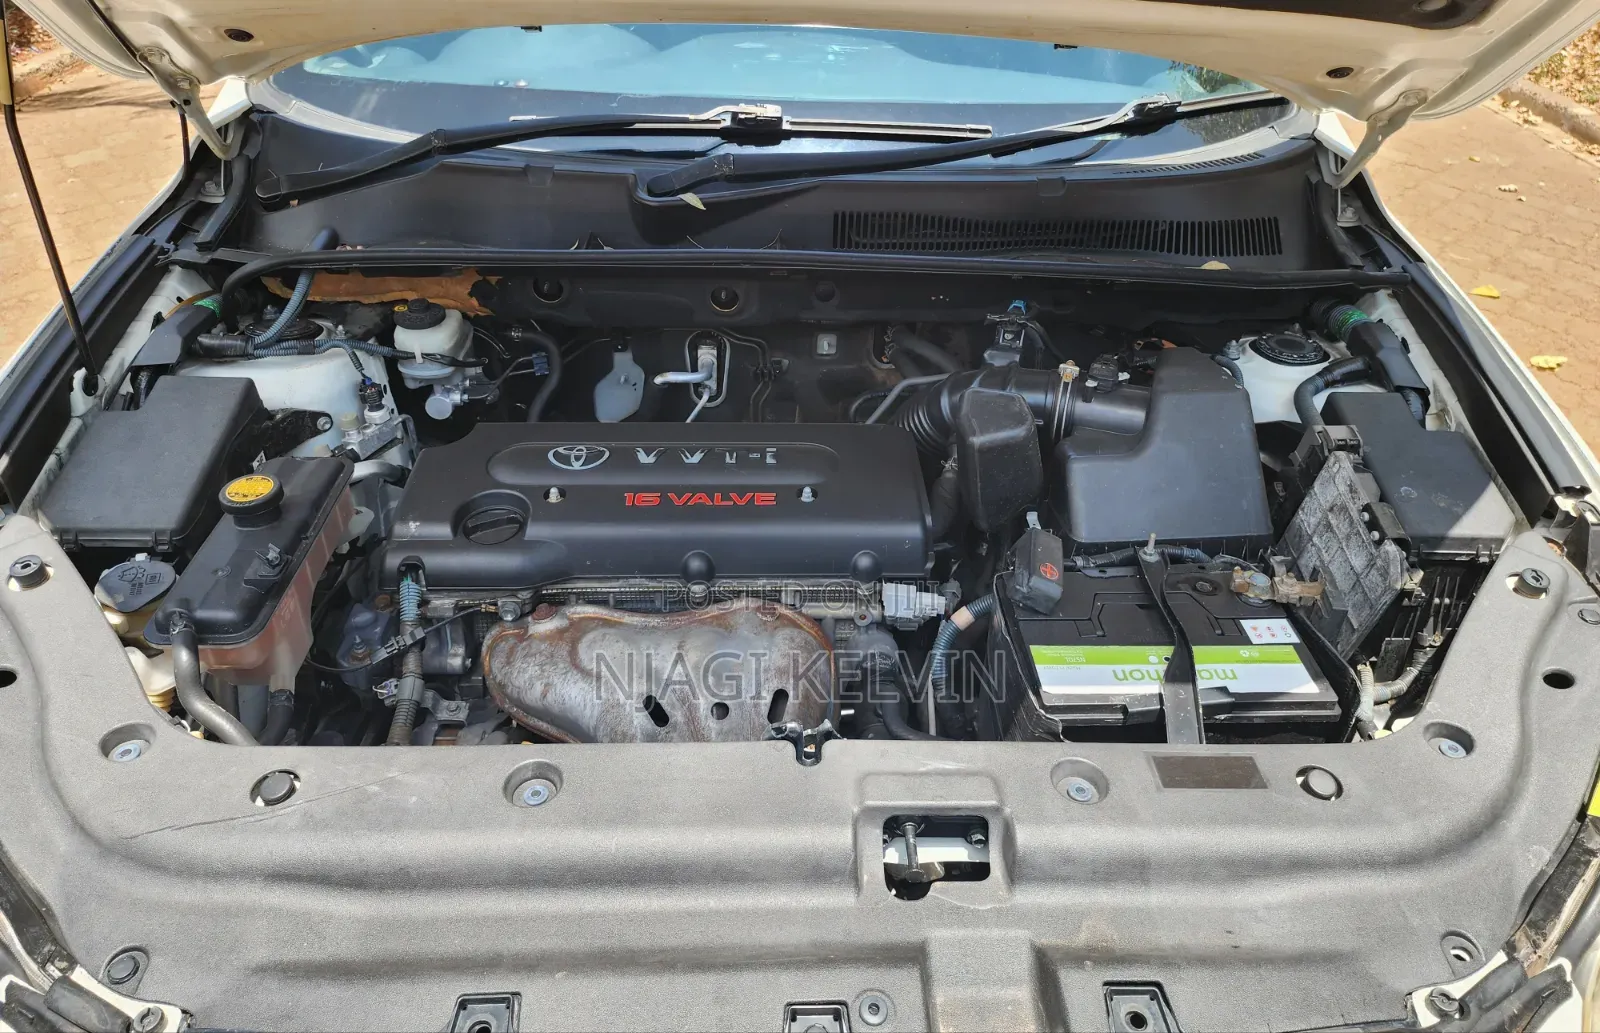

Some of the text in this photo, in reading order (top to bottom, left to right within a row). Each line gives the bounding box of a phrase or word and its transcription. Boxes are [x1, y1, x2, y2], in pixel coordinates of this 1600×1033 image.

[624, 492, 777, 506] 16 VALVE
[1112, 668, 1238, 685] mahon
